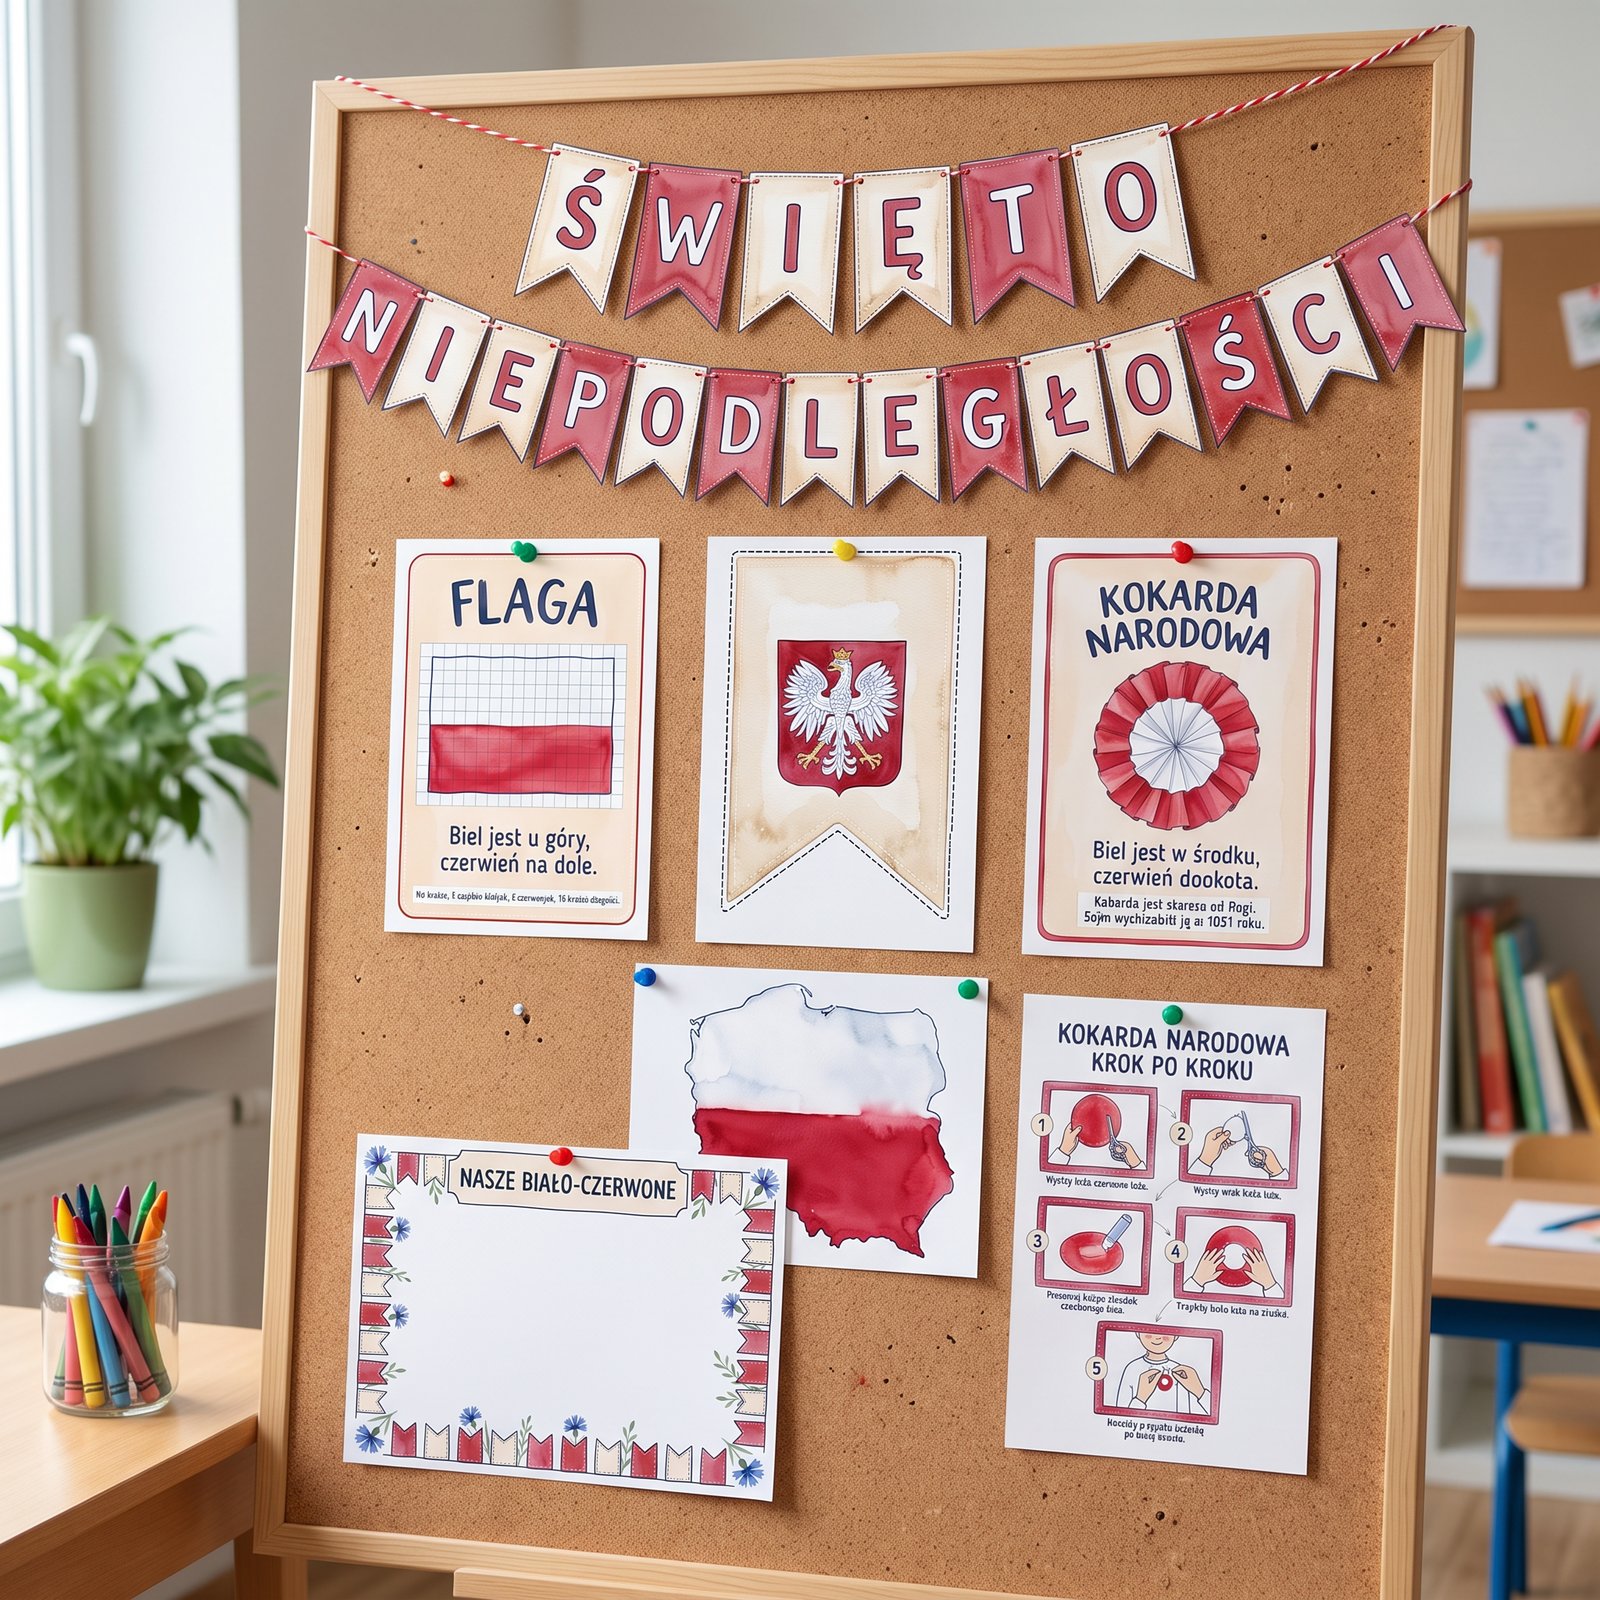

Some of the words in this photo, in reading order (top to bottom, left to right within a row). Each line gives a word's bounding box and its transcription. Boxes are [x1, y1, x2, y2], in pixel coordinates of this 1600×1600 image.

[556, 160, 1158, 280] ŚWIĘTO
[341, 252, 1415, 459] NIEPODLEGŁOŚCI
[451, 577, 599, 628] FLAGA
[1099, 579, 1258, 619] KOKARDA
[1085, 617, 1270, 661] NARODOWA
[449, 825, 482, 846] Biel
[487, 827, 522, 852] jest
[528, 832, 539, 847] u
[545, 827, 591, 854] góry,
[440, 852, 519, 874] czerwień
[526, 859, 548, 874] na
[554, 853, 598, 876] dole.
[1093, 840, 1126, 860] Biel
[1131, 842, 1166, 866] jest
[1172, 848, 1187, 862] w
[1193, 843, 1260, 869] środku,
[1093, 867, 1173, 887] czerwień
[558, 894, 567, 903] 16
[1094, 896, 1139, 909] Kabarda
[1142, 897, 1163, 912] jest
[1210, 900, 1224, 912] od
[1228, 900, 1256, 917] Rogi.
[1207, 915, 1233, 928] 1051
[1237, 916, 1265, 930] roku.
[1058, 1022, 1157, 1050] KOKARDA
[1167, 1028, 1290, 1057] NARODOWA
[1092, 1052, 1144, 1075] KROK
[1152, 1056, 1178, 1076] PO
[1186, 1057, 1253, 1081] KROKU
[1038, 1118, 1046, 1132] 1
[1177, 1127, 1186, 1141] 2
[460, 1167, 516, 1191] NASZE
[522, 1171, 677, 1201] BIAŁO-CZERWONE
[1033, 1234, 1043, 1248] 3
[1171, 1244, 1181, 1258] 4
[1249, 1308, 1259, 1316] na
[1092, 1361, 1101, 1376] 5
